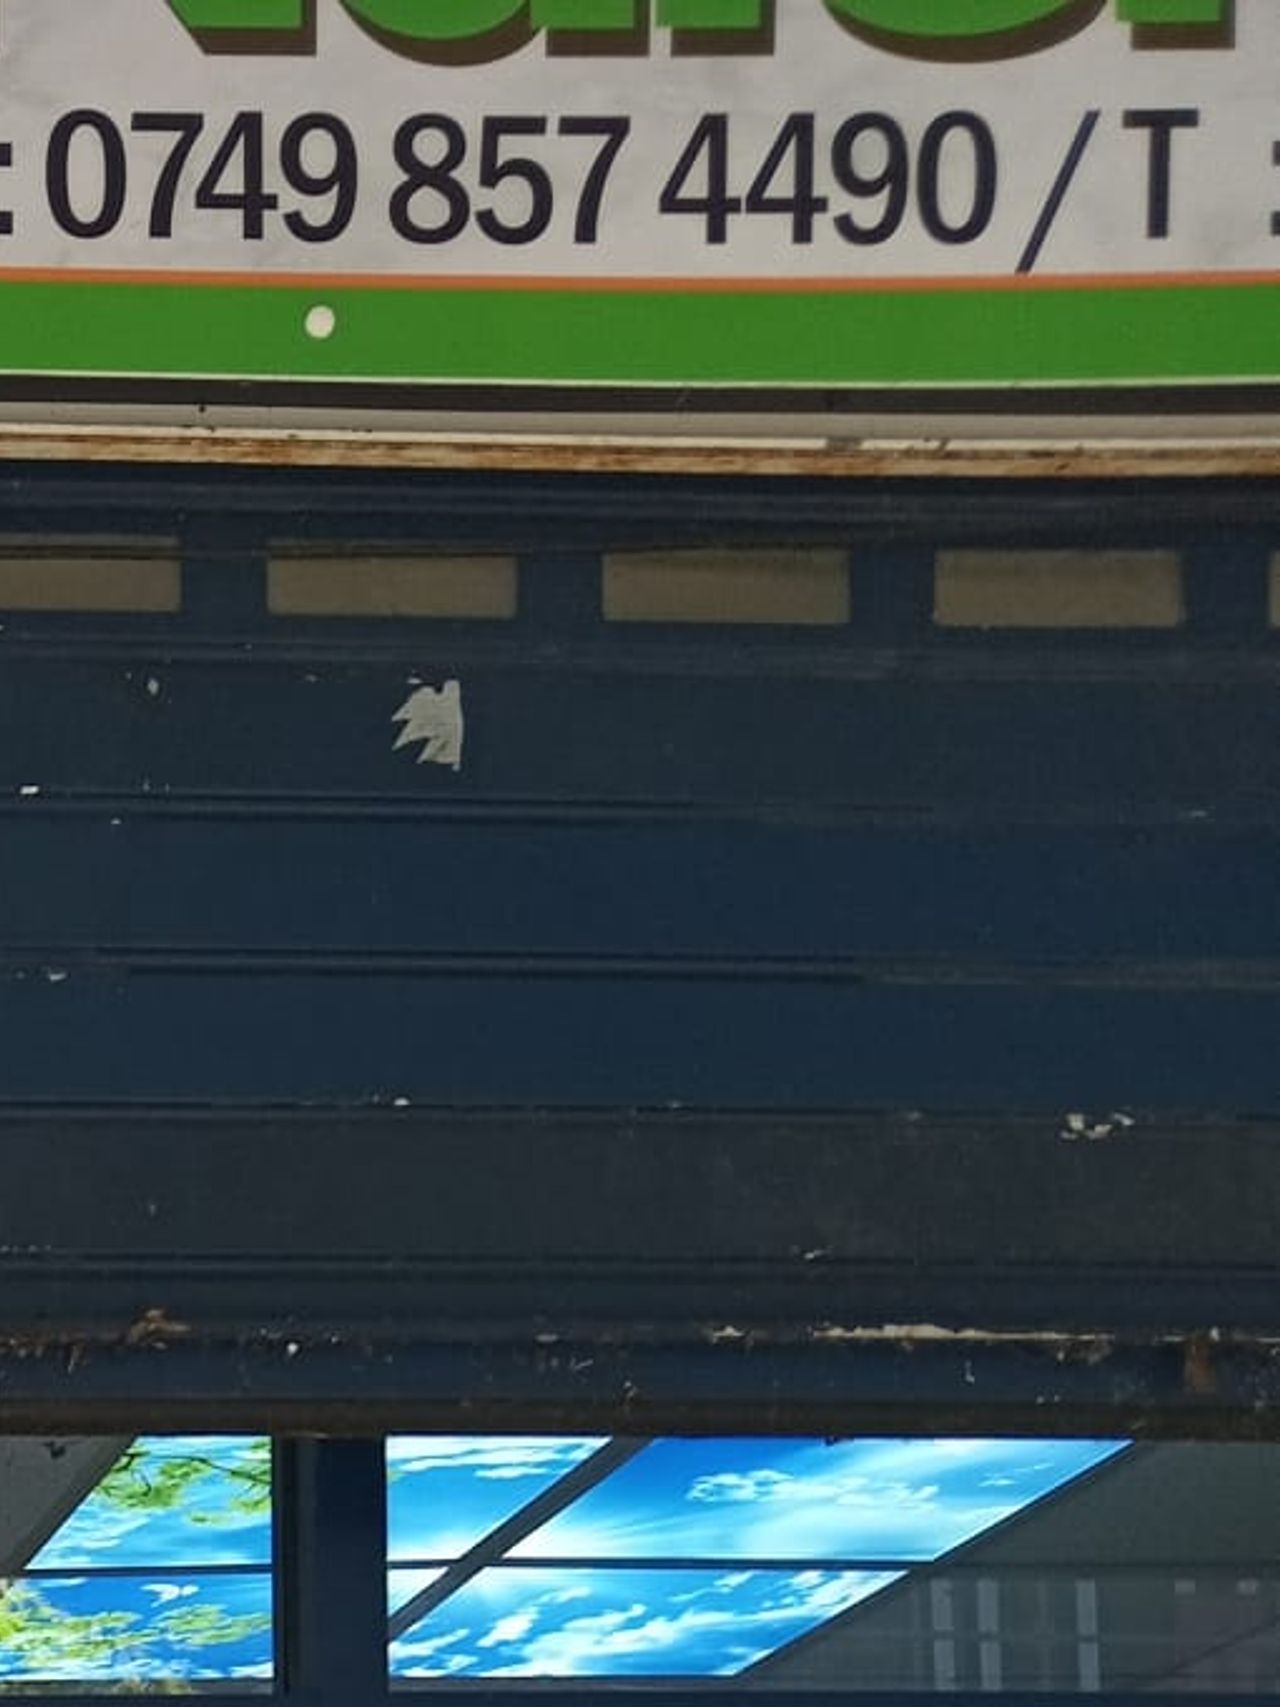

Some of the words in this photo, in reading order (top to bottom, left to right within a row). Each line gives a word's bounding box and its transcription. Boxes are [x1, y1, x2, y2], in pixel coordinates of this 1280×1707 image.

[44, 107, 359, 242] 0749
[387, 112, 632, 246] 857
[657, 108, 999, 246] 4490
[1121, 108, 1201, 239] T
